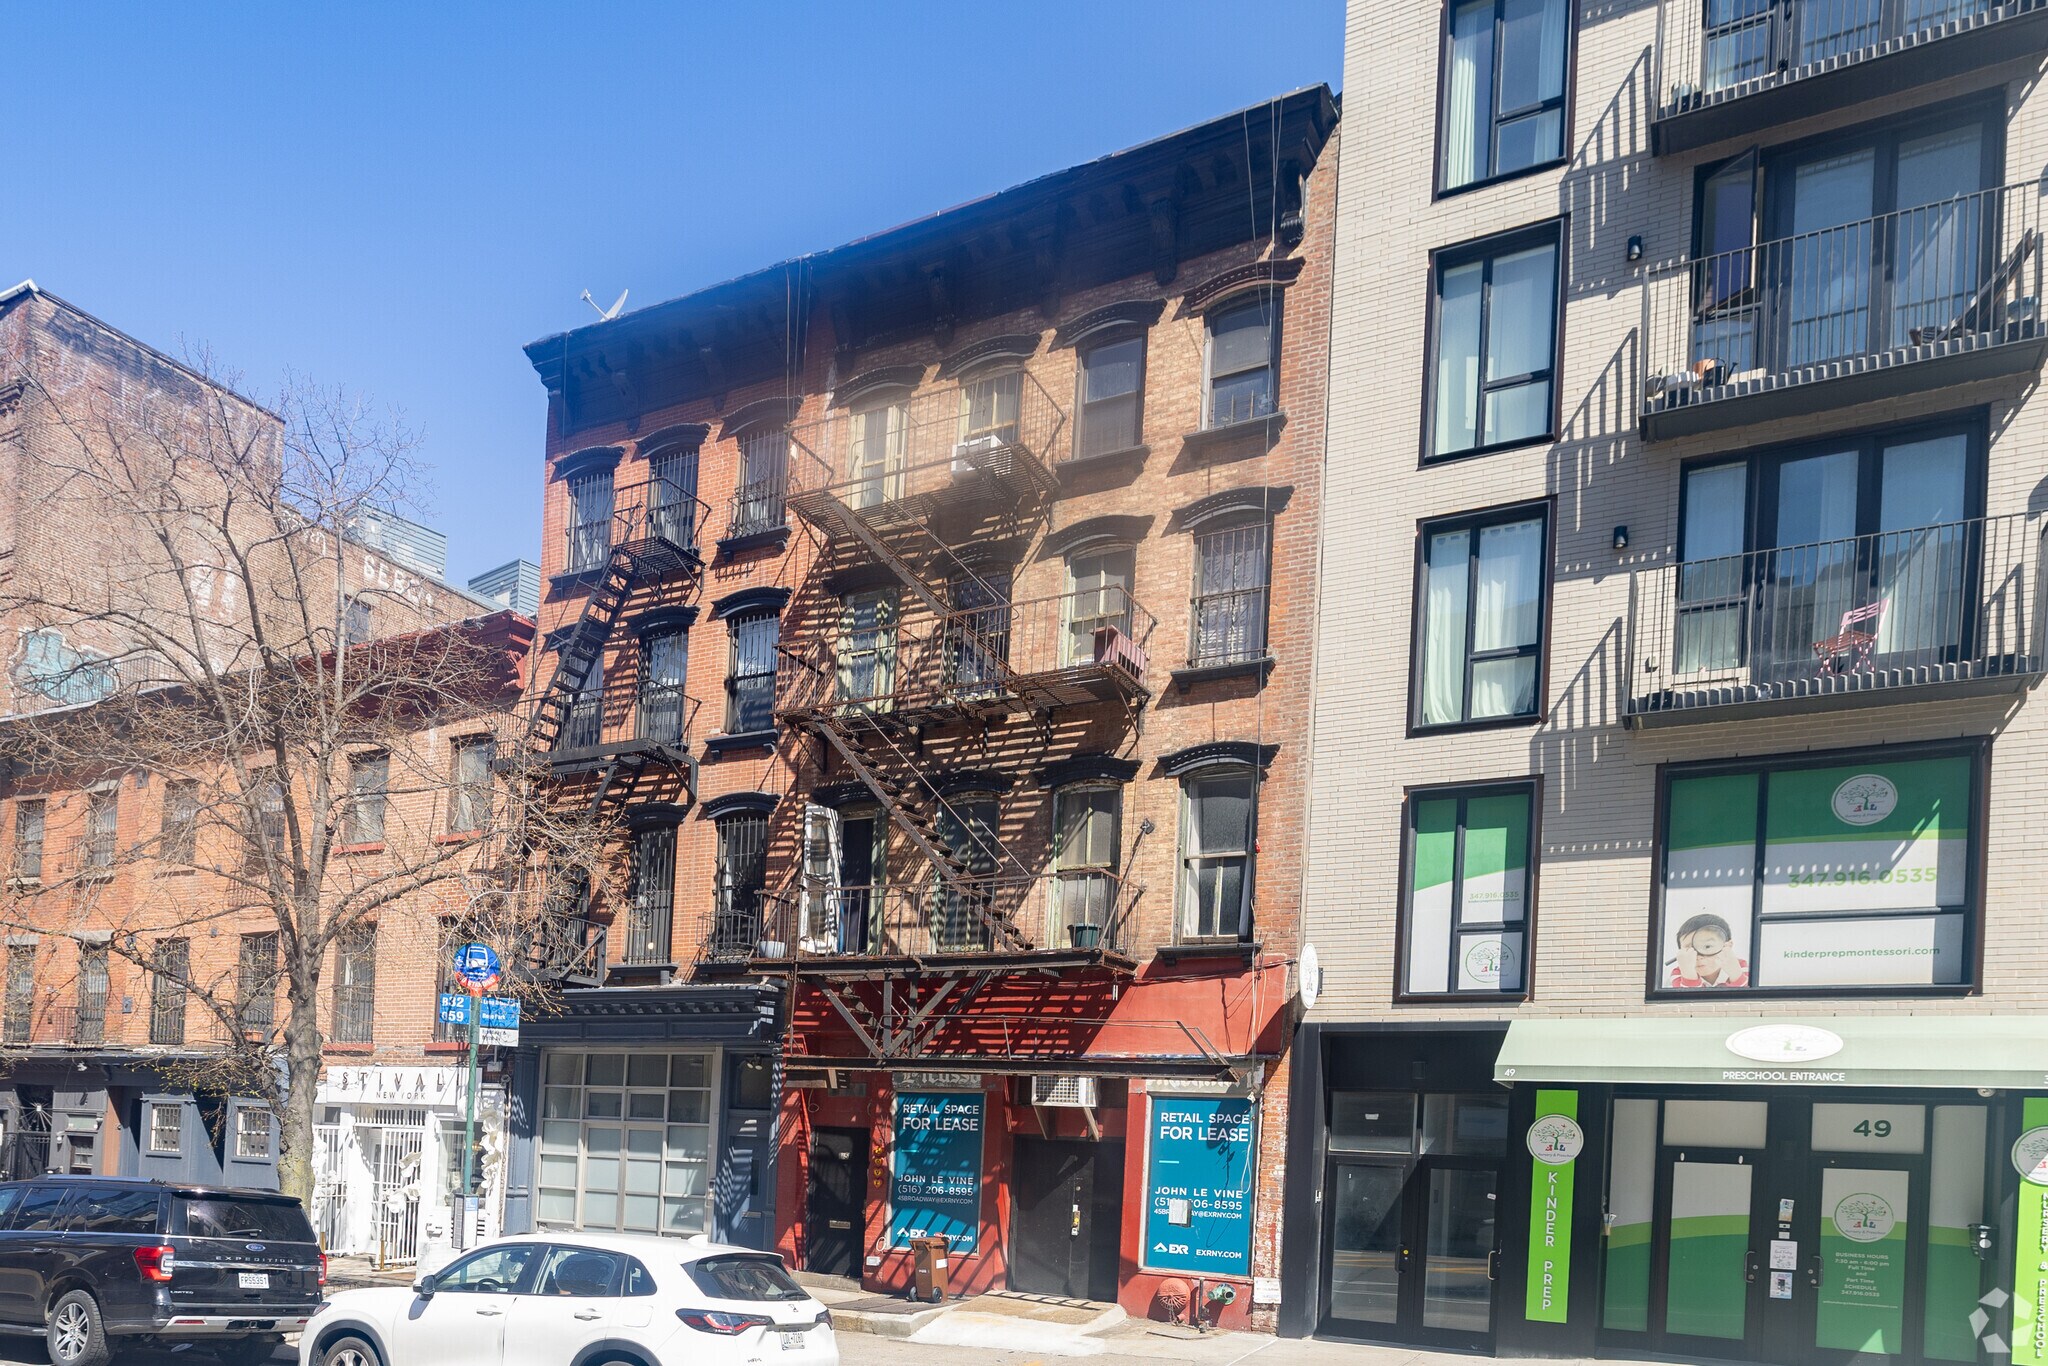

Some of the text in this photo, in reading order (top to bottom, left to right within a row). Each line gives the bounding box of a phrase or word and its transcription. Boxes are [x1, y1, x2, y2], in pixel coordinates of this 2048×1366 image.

[1788, 867, 1937, 888] 347.916.0535
[1784, 947, 1940, 959] kinderprepmontessori.com
[442, 996, 464, 1008] B32
[1504, 1068, 1516, 1077] 49
[1722, 1071, 1846, 1081] PRESCHOOL ENTRANCE
[401, 1092, 426, 1100] YORK
[902, 1104, 980, 1115] RETAIL SPACE
[902, 1117, 979, 1131] FOR LEASE
[1161, 1112, 1250, 1124] RETAIL SPACE
[1160, 1126, 1249, 1142] FOR LEASE
[1853, 1119, 1892, 1138] 49
[898, 1174, 974, 1185] JOHN LE VINE
[897, 1184, 973, 1196] (516) 206-8595
[1155, 1186, 1243, 1198] JOHN LE VINE
[1187, 1198, 1243, 1210] 06-8595
[1545, 1171, 1558, 1247] KINDER
[1168, 1243, 1189, 1254] EXR
[1195, 1249, 1242, 1259] EXRNY.COM
[1542, 1261, 1553, 1310] PREP
[2035, 1279, 2047, 1357] PRESCHOOL
